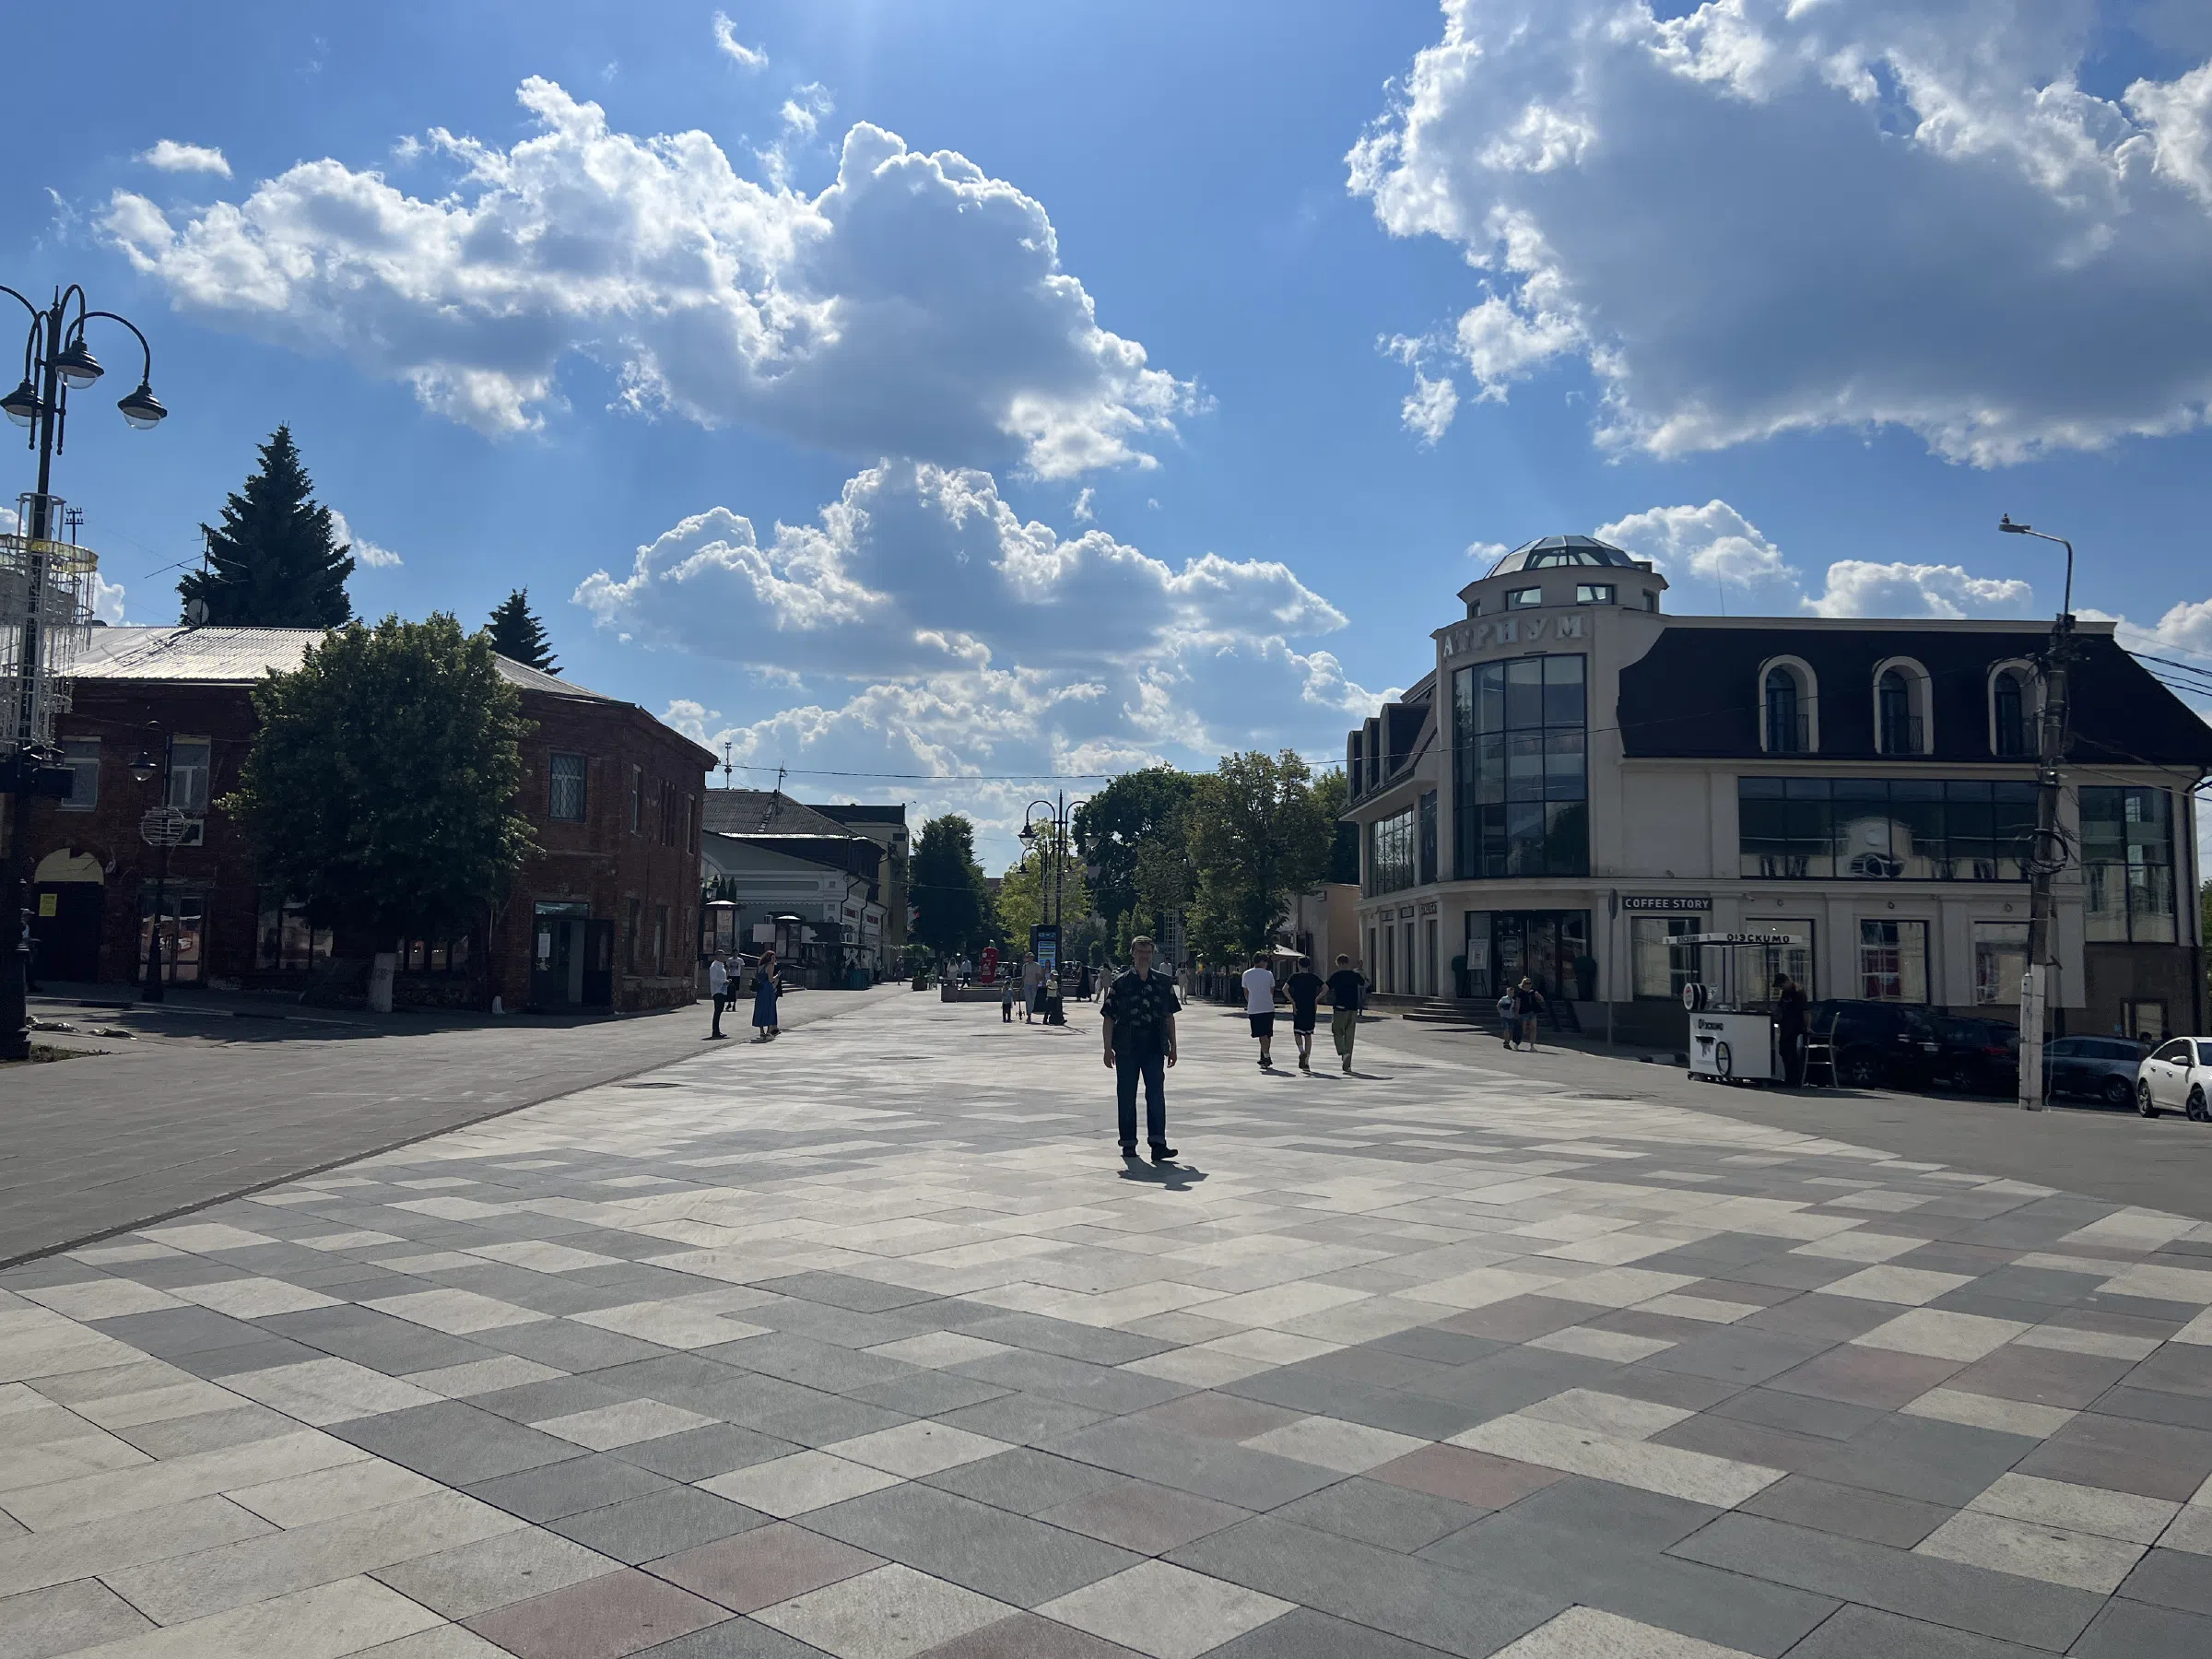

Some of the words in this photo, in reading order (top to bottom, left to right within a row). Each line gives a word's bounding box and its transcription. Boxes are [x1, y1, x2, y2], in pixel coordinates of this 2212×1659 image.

[1442, 615, 1584, 657] АТРИУМ
[1625, 899, 1669, 908] COFFEE
[1673, 900, 1709, 908] STORY
